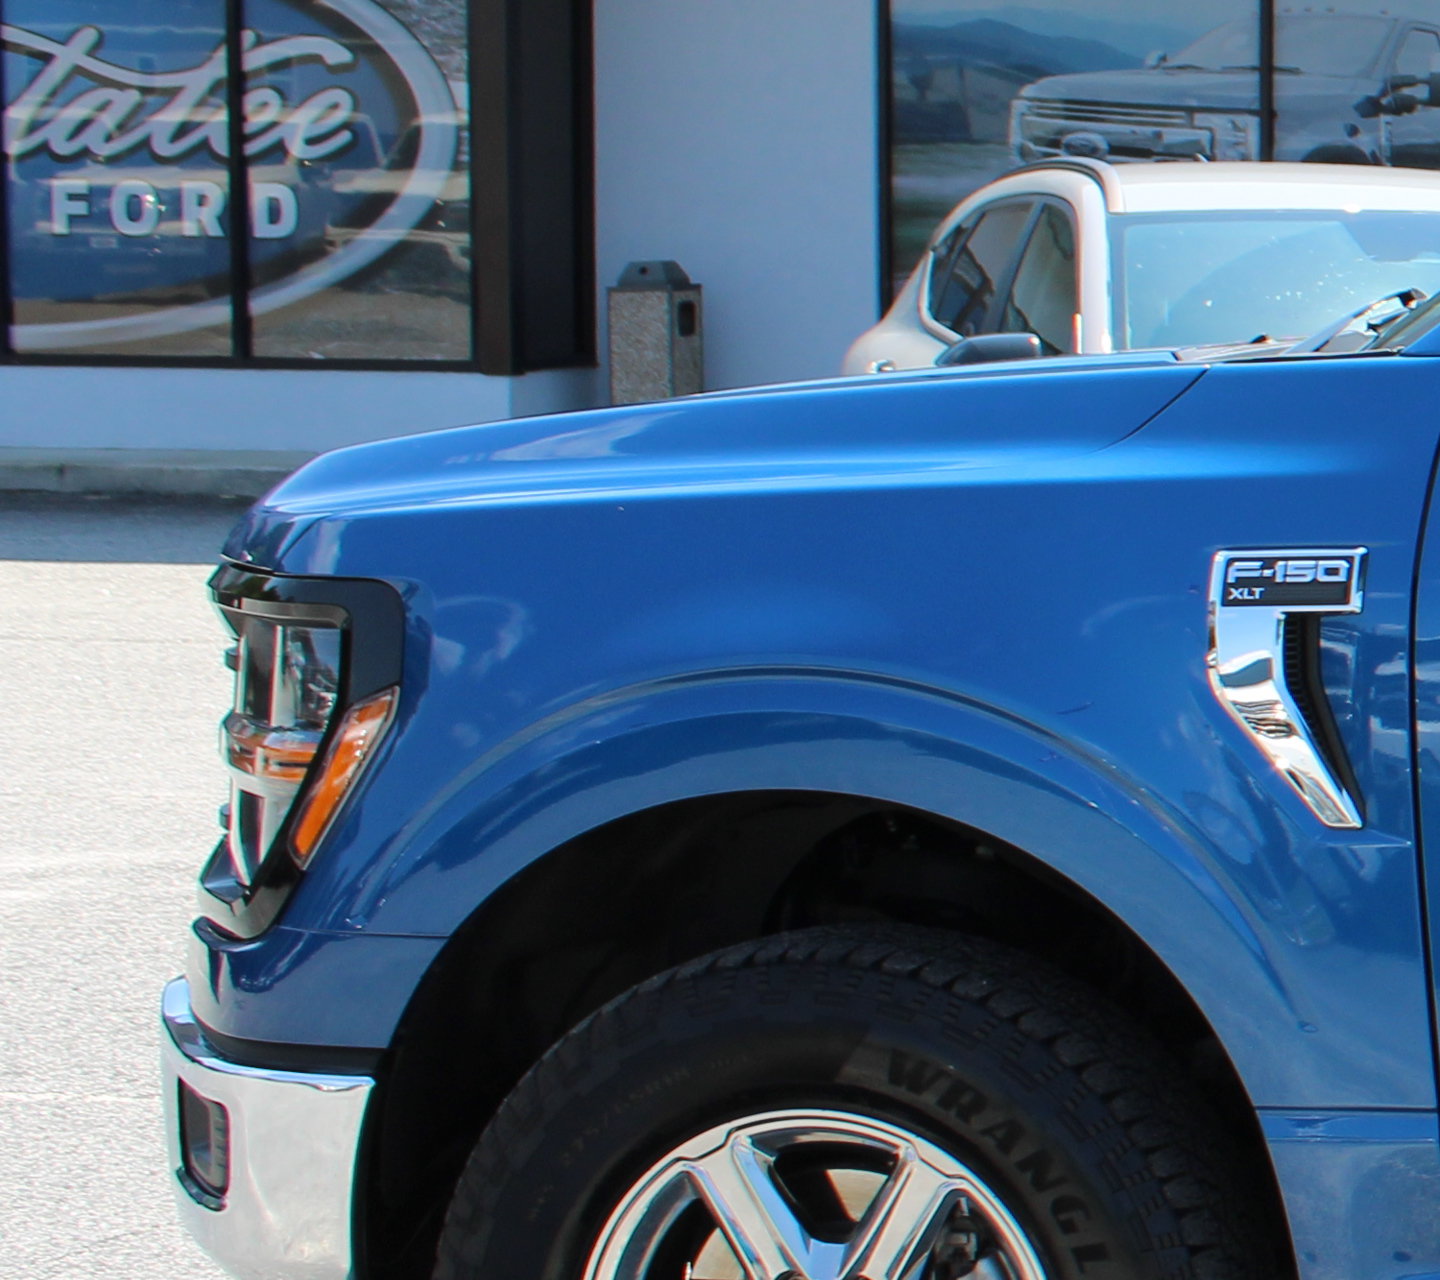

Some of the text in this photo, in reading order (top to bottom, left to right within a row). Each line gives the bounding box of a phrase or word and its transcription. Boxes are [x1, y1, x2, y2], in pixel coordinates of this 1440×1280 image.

[49, 179, 300, 241] FORD
[1226, 560, 1350, 584] F-150
[1227, 586, 1264, 601] XLT
